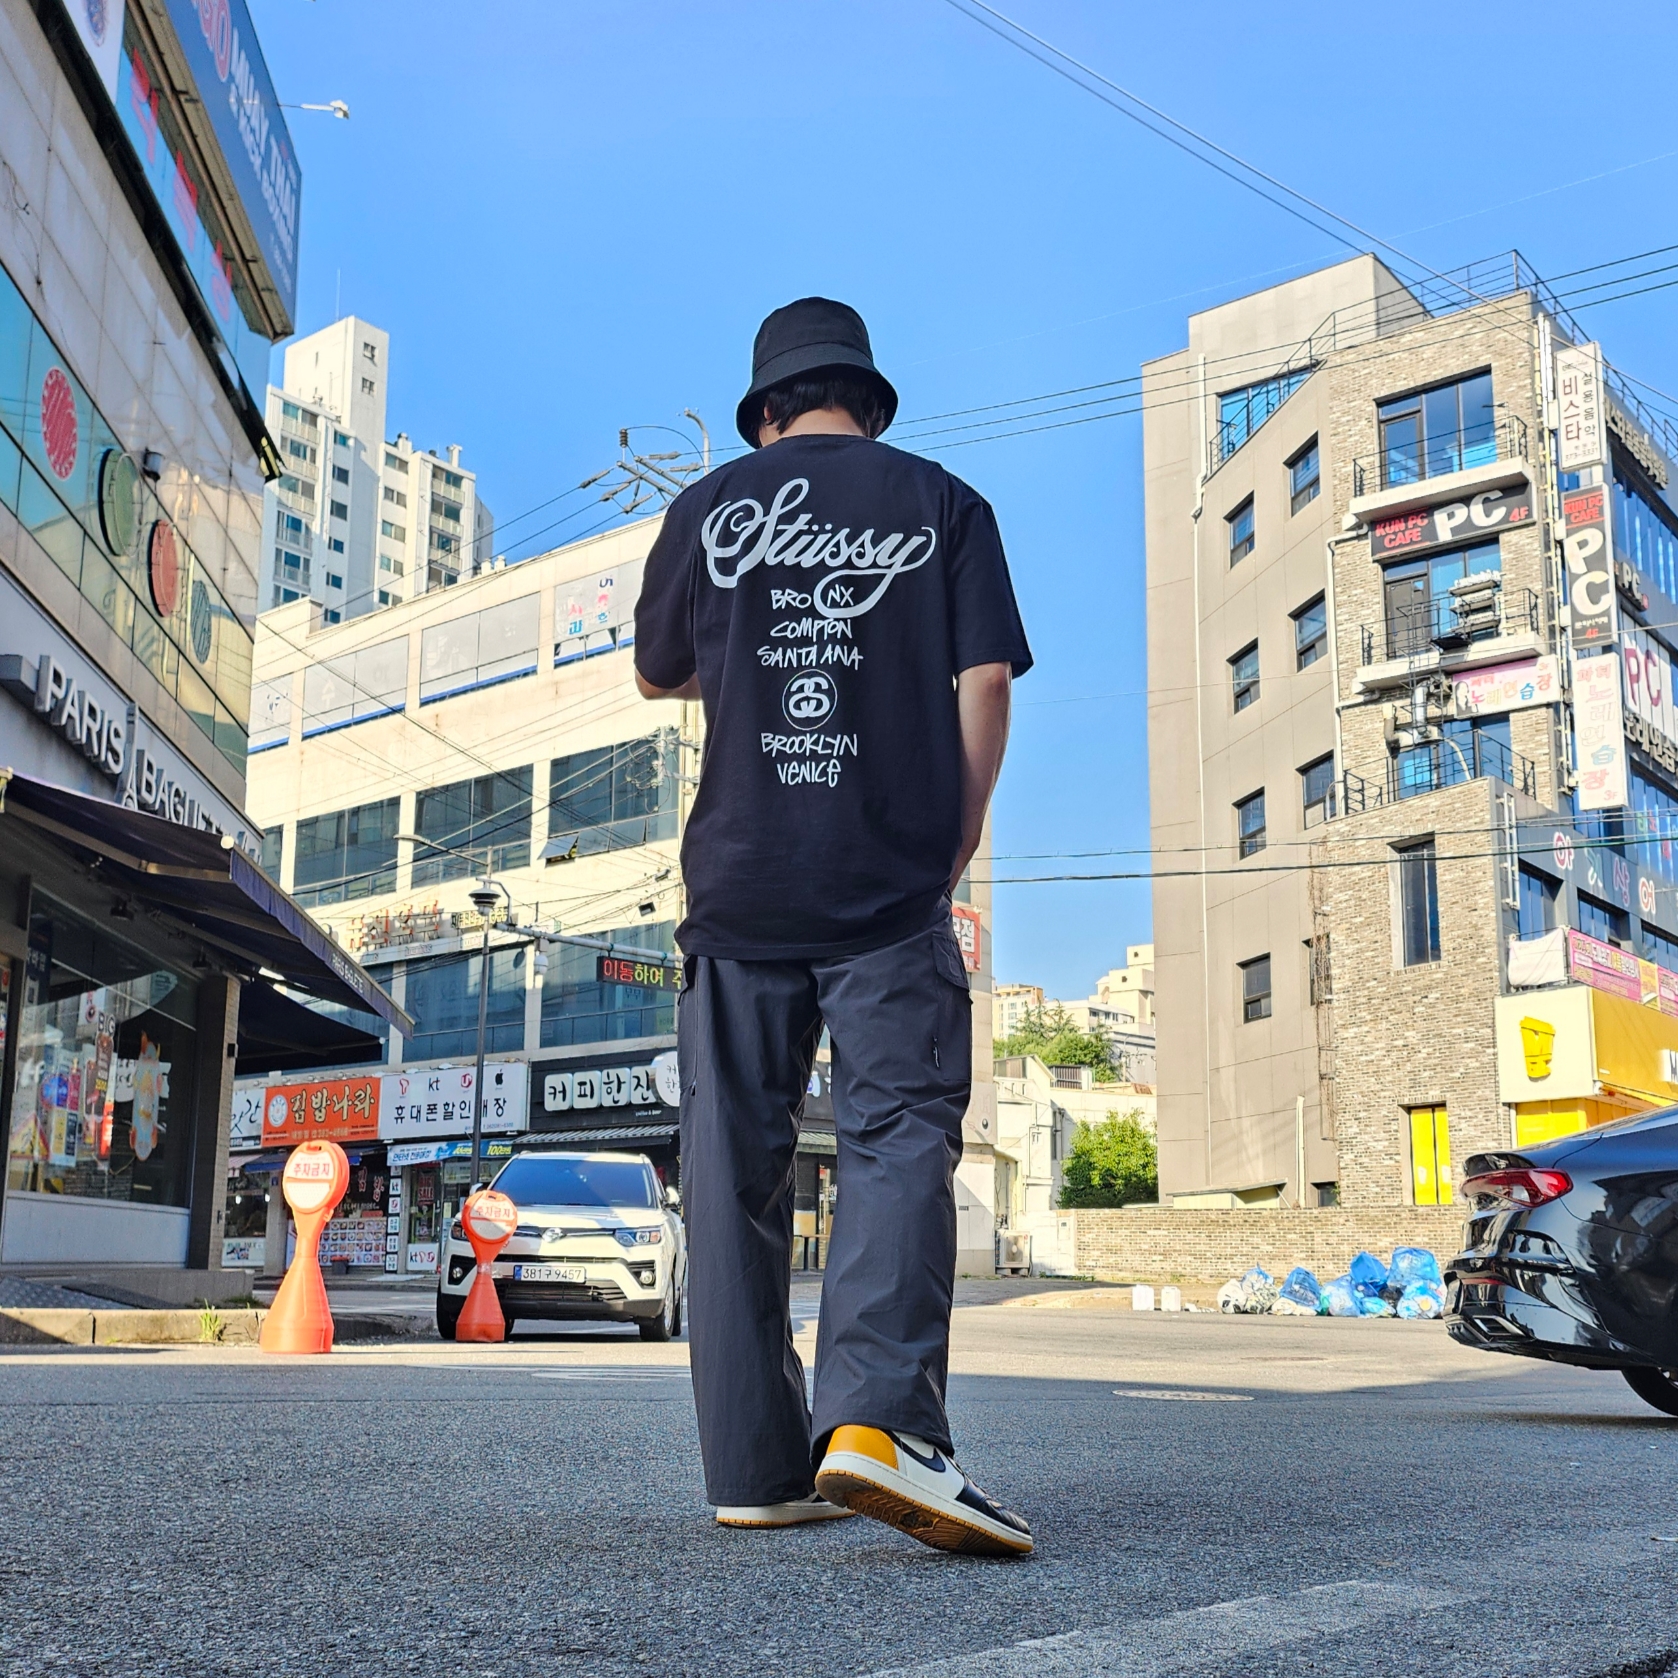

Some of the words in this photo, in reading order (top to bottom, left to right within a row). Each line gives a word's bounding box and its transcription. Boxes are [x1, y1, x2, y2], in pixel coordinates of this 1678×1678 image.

[1562, 375, 1581, 441] 비스타
[1581, 372, 1596, 438] 실용음악
[1433, 490, 1507, 542] PC
[1509, 506, 1529, 522] 4F
[1564, 500, 1587, 514] KUN
[1587, 495, 1604, 508] PC
[1570, 508, 1599, 523] CAFE
[1375, 518, 1404, 537] KUN
[1407, 512, 1428, 529] PC
[701, 477, 936, 618] Stüssy
[1384, 531, 1421, 548] CAFE
[1563, 527, 1611, 616] PC
[1622, 561, 1642, 601] PC
[770, 584, 854, 609] BRONX
[770, 617, 852, 642] COMPTON
[757, 645, 818, 668] SANTA
[820, 646, 863, 670] ANA
[1624, 646, 1661, 708] PC
[36, 655, 125, 775] PARIS
[761, 733, 858, 757] BROOKLYN
[1623, 709, 1678, 774] 노래연습
[603, 959, 664, 988] 이동하여
[98, 1011, 116, 1036] BIG
[428, 1077, 441, 1091] kt
[290, 1082, 376, 1125] 김밥나라
[293, 1162, 331, 1177] 주차금지
[391, 1182, 399, 1192] kt
[476, 1204, 511, 1218] 주차금지
[409, 1251, 418, 1263] kt
[522, 1267, 552, 1280] 381구
[554, 1268, 582, 1280] 9457
